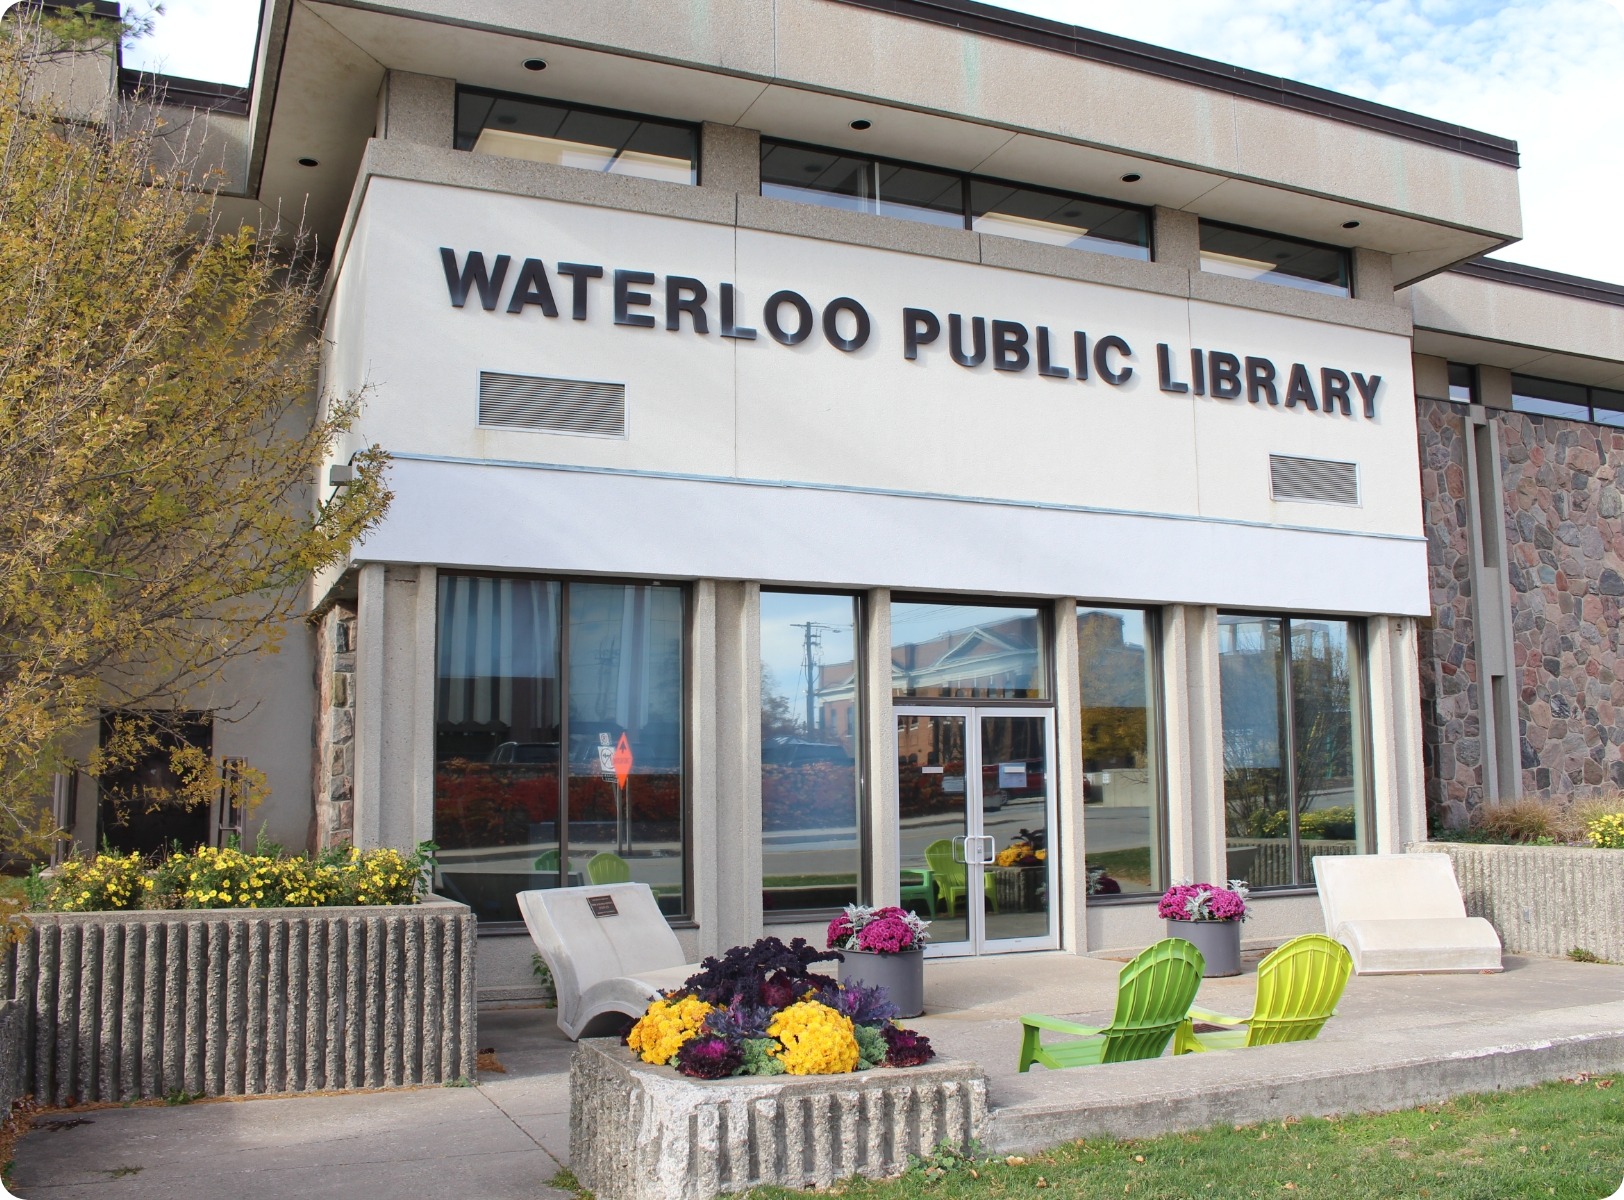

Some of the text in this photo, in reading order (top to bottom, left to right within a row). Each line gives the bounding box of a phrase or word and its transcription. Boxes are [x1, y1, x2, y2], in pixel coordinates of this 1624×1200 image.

[439, 246, 1382, 419] WATERLOO PUBLIC LIBRARY
